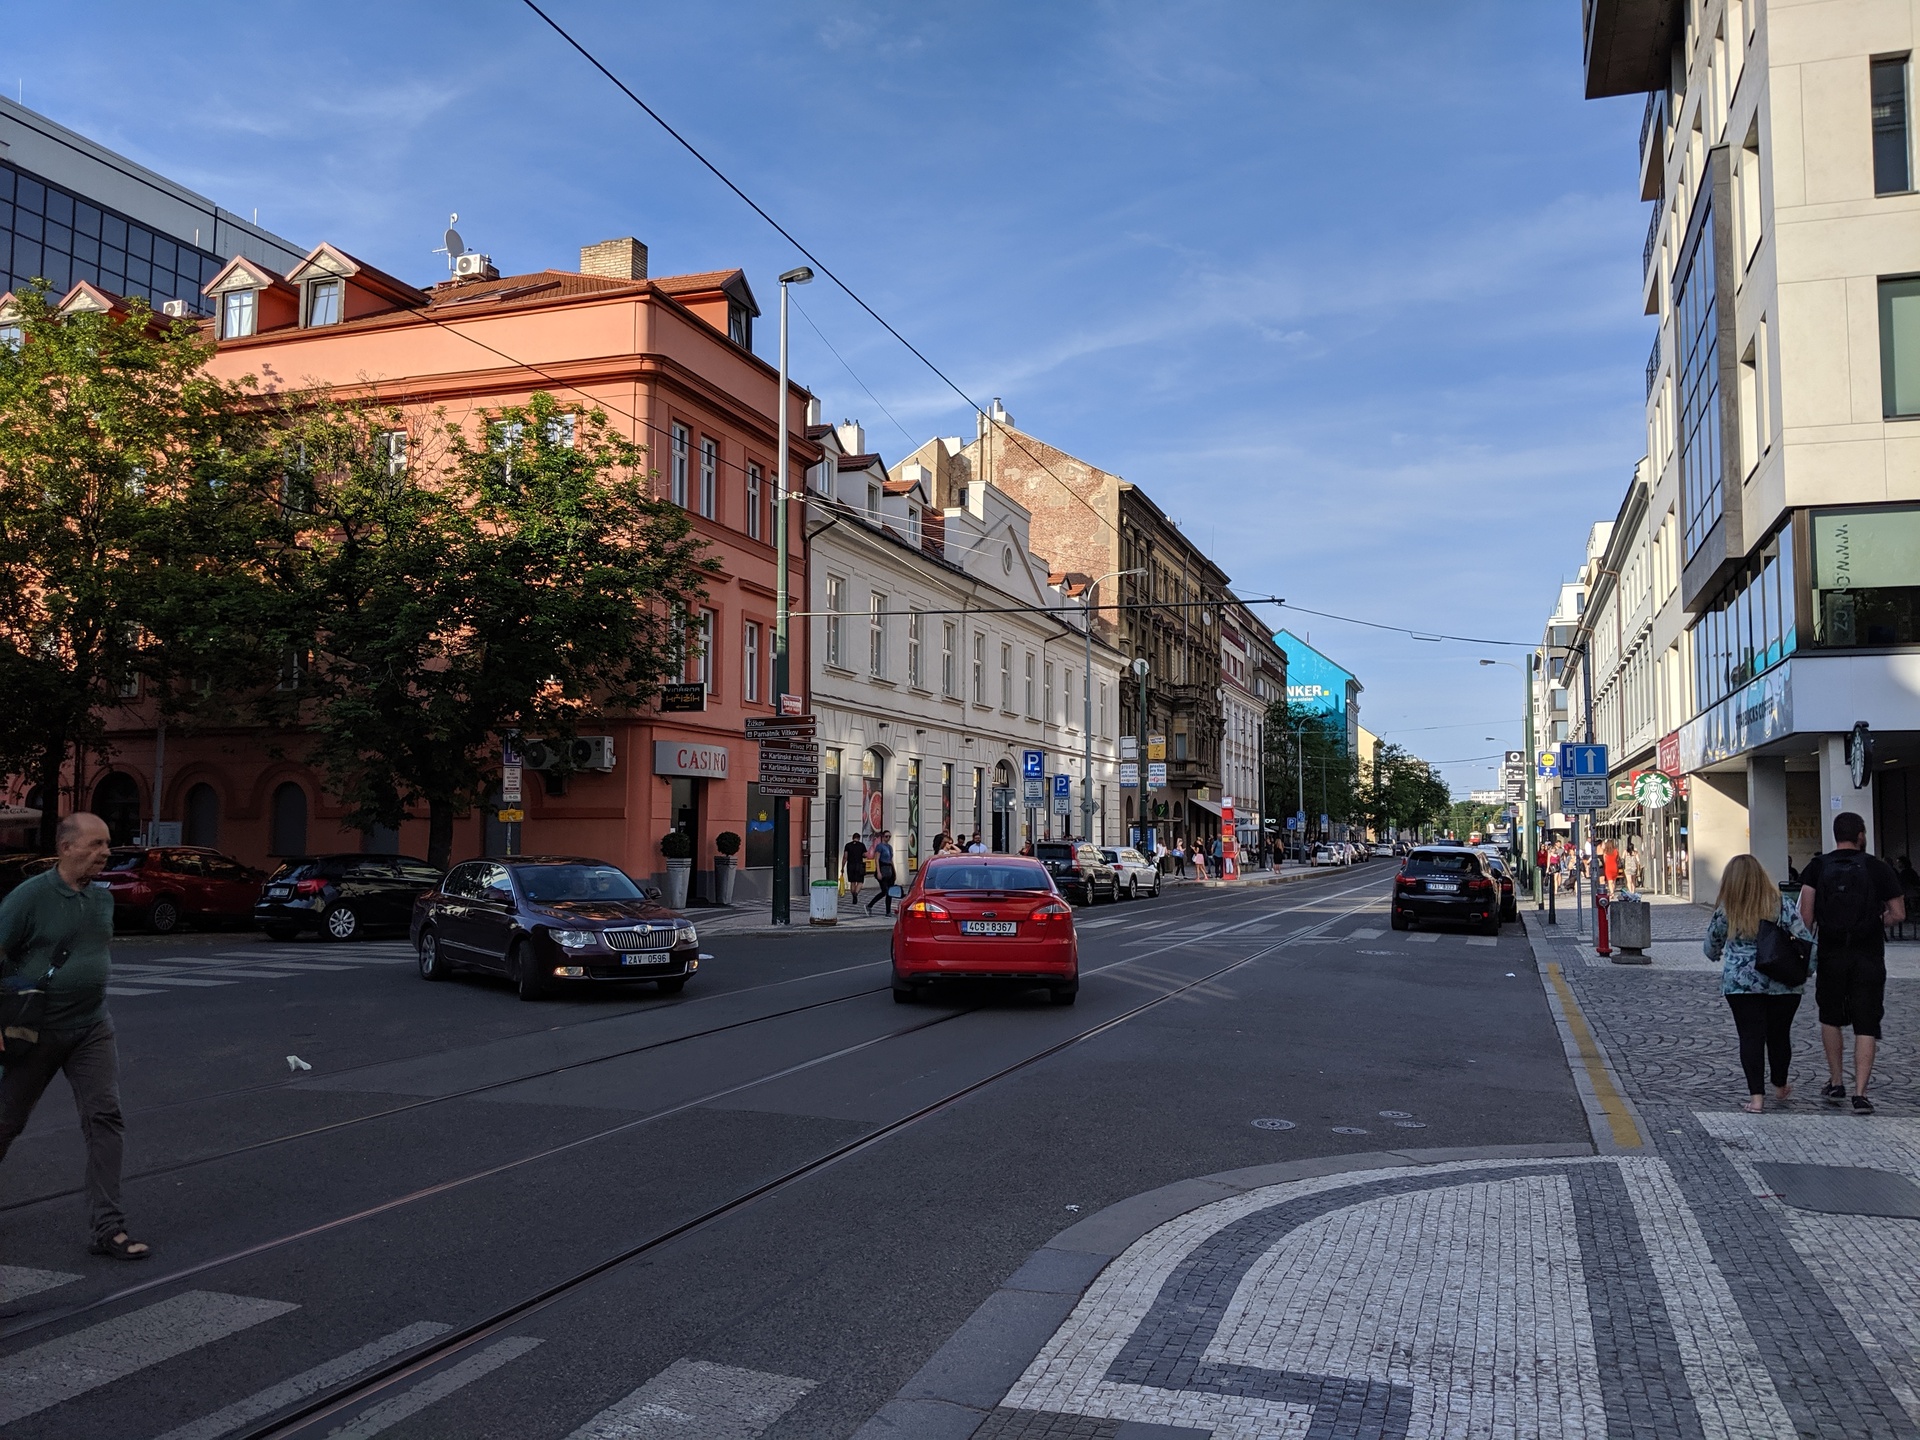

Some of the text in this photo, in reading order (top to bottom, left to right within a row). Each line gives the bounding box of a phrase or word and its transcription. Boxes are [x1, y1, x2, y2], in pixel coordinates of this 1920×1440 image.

[747, 719, 766, 727] Žižkov
[753, 730, 780, 738] Památník
[677, 749, 727, 772] CASINO
[792, 754, 812, 762] náměstí
[1028, 754, 1039, 771] P
[791, 766, 813, 775] synagoga
[787, 776, 807, 784] náměstí
[1057, 778, 1066, 791] P
[767, 786, 794, 795] Invalidovna
[969, 922, 1013, 932] 4C9 8367
[628, 954, 667, 965] 2AV 0596
